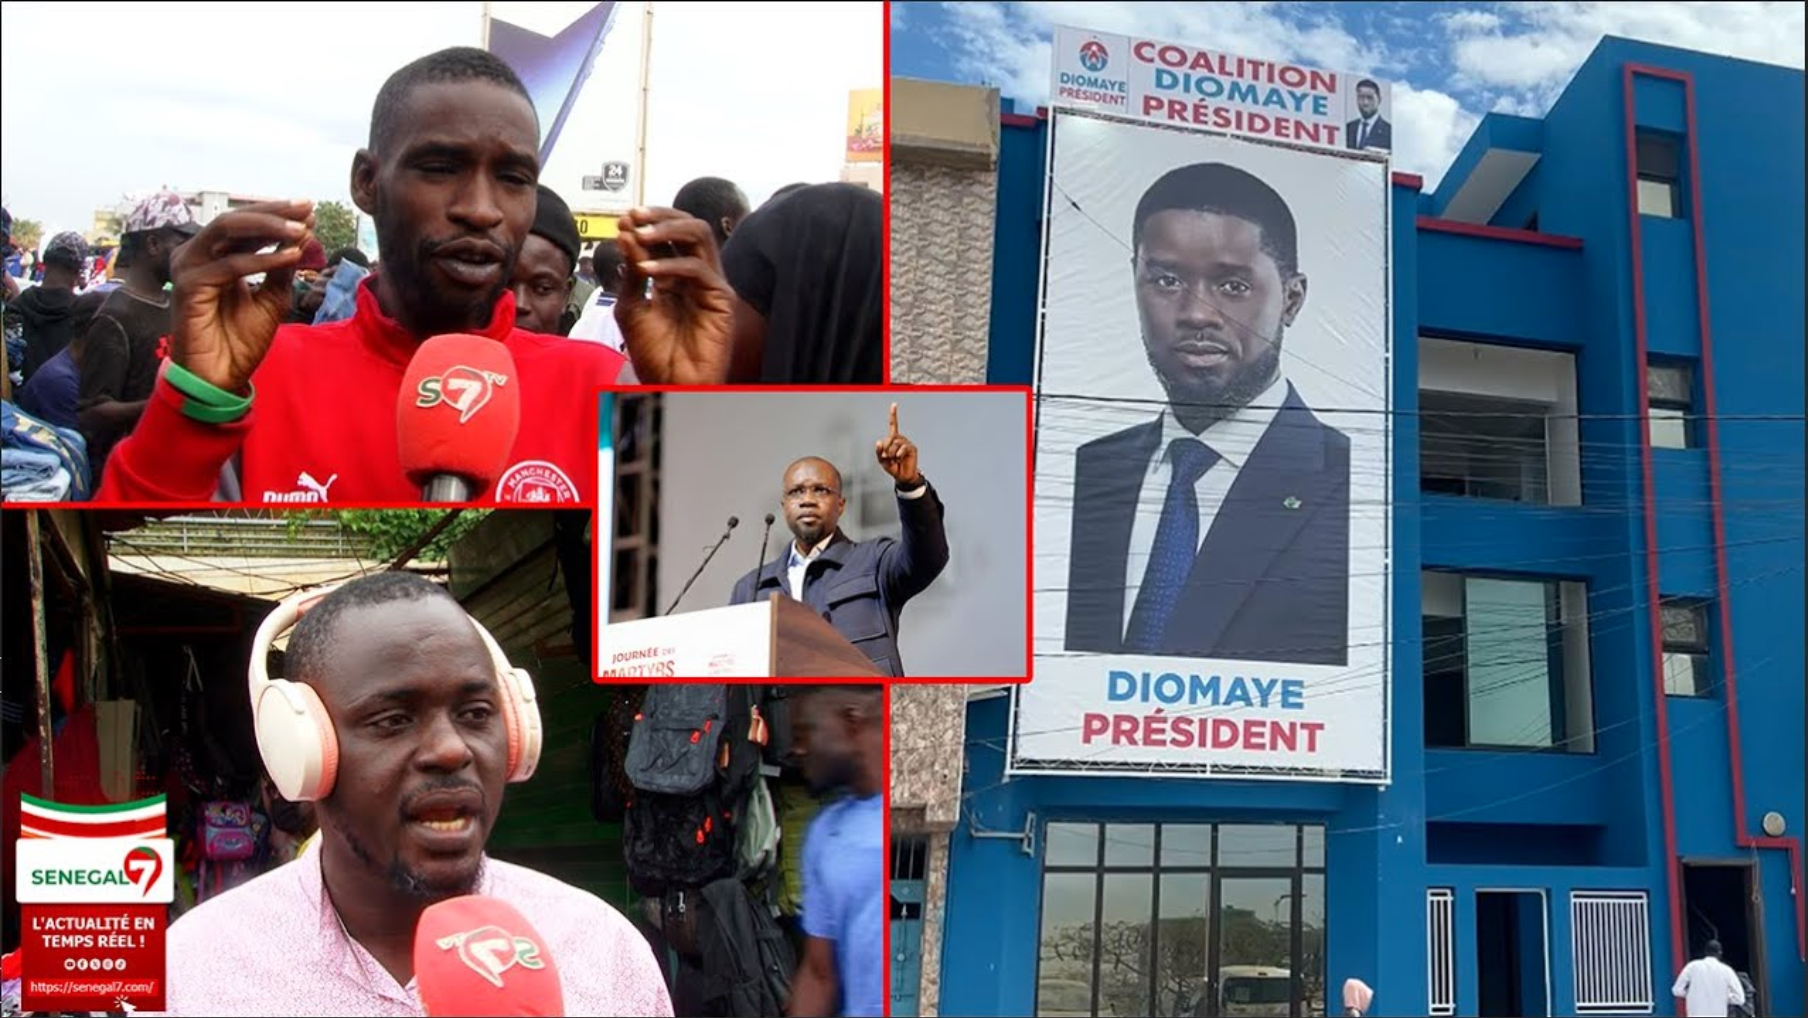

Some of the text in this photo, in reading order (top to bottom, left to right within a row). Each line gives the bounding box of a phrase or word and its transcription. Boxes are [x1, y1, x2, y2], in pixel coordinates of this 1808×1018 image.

[1060, 71, 1126, 93] DIOMAYE
[1133, 41, 1337, 94] COALITION
[1155, 67, 1329, 117] DIOMAYE
[1143, 94, 1341, 146] PRÉSIDENT
[608, 164, 623, 176] 24
[507, 467, 571, 499] MANCHESTER
[612, 646, 659, 664] JOURNÉE
[1107, 670, 1305, 710] DIOMAYE
[1082, 707, 1325, 753] PRÉSIDENT
